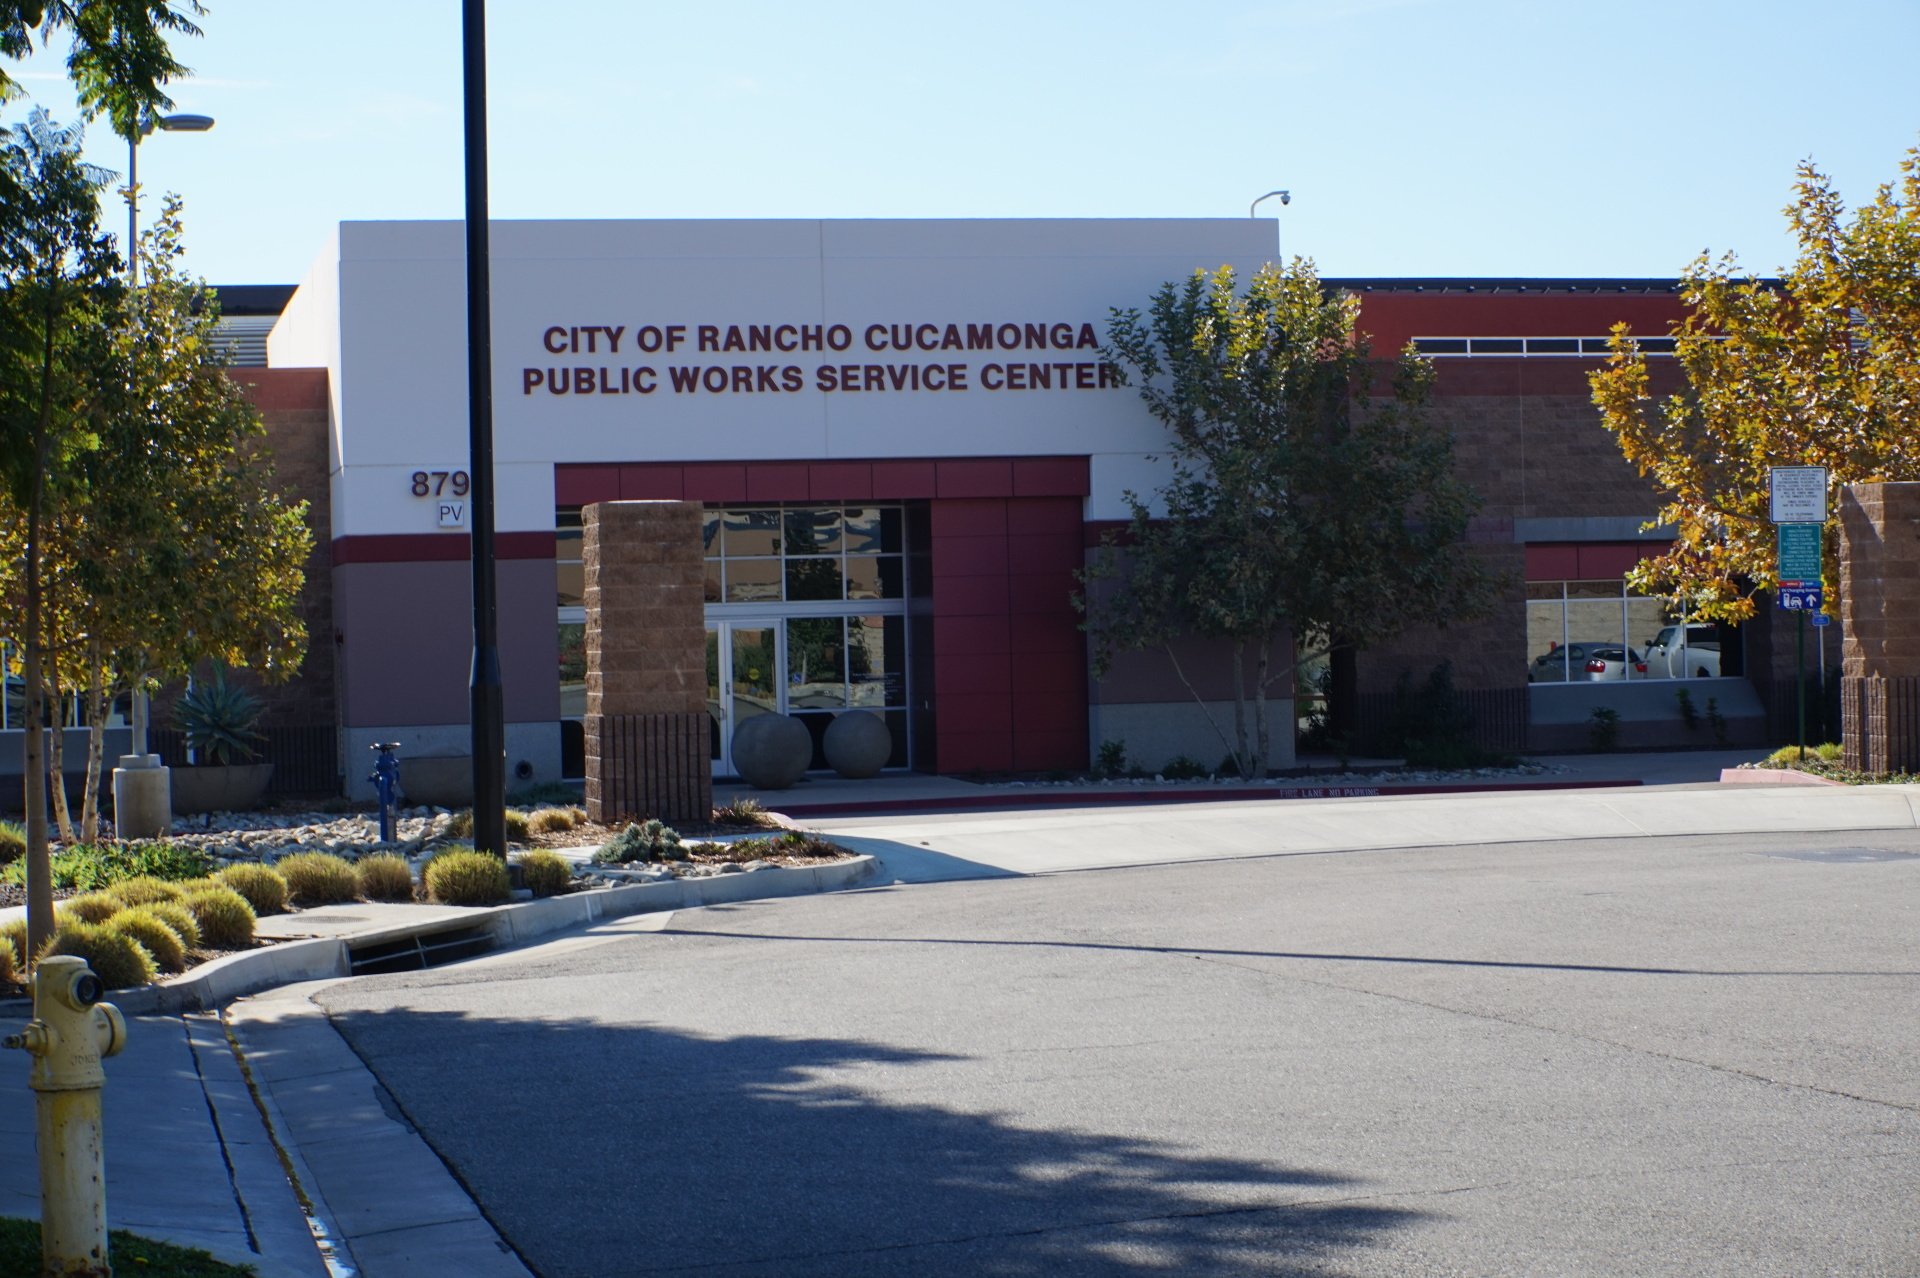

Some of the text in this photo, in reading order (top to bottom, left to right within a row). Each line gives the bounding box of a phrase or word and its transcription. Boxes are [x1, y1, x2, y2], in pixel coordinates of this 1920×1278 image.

[543, 322, 1099, 353] CITY OF RANCHO CUCAMONGA
[523, 362, 1120, 395] PUBLIC WORKS SERVICE CENTER
[411, 470, 470, 497] 879
[440, 505, 462, 521] PV
[1280, 787, 1379, 799] FIRE LANE NO PARKING
